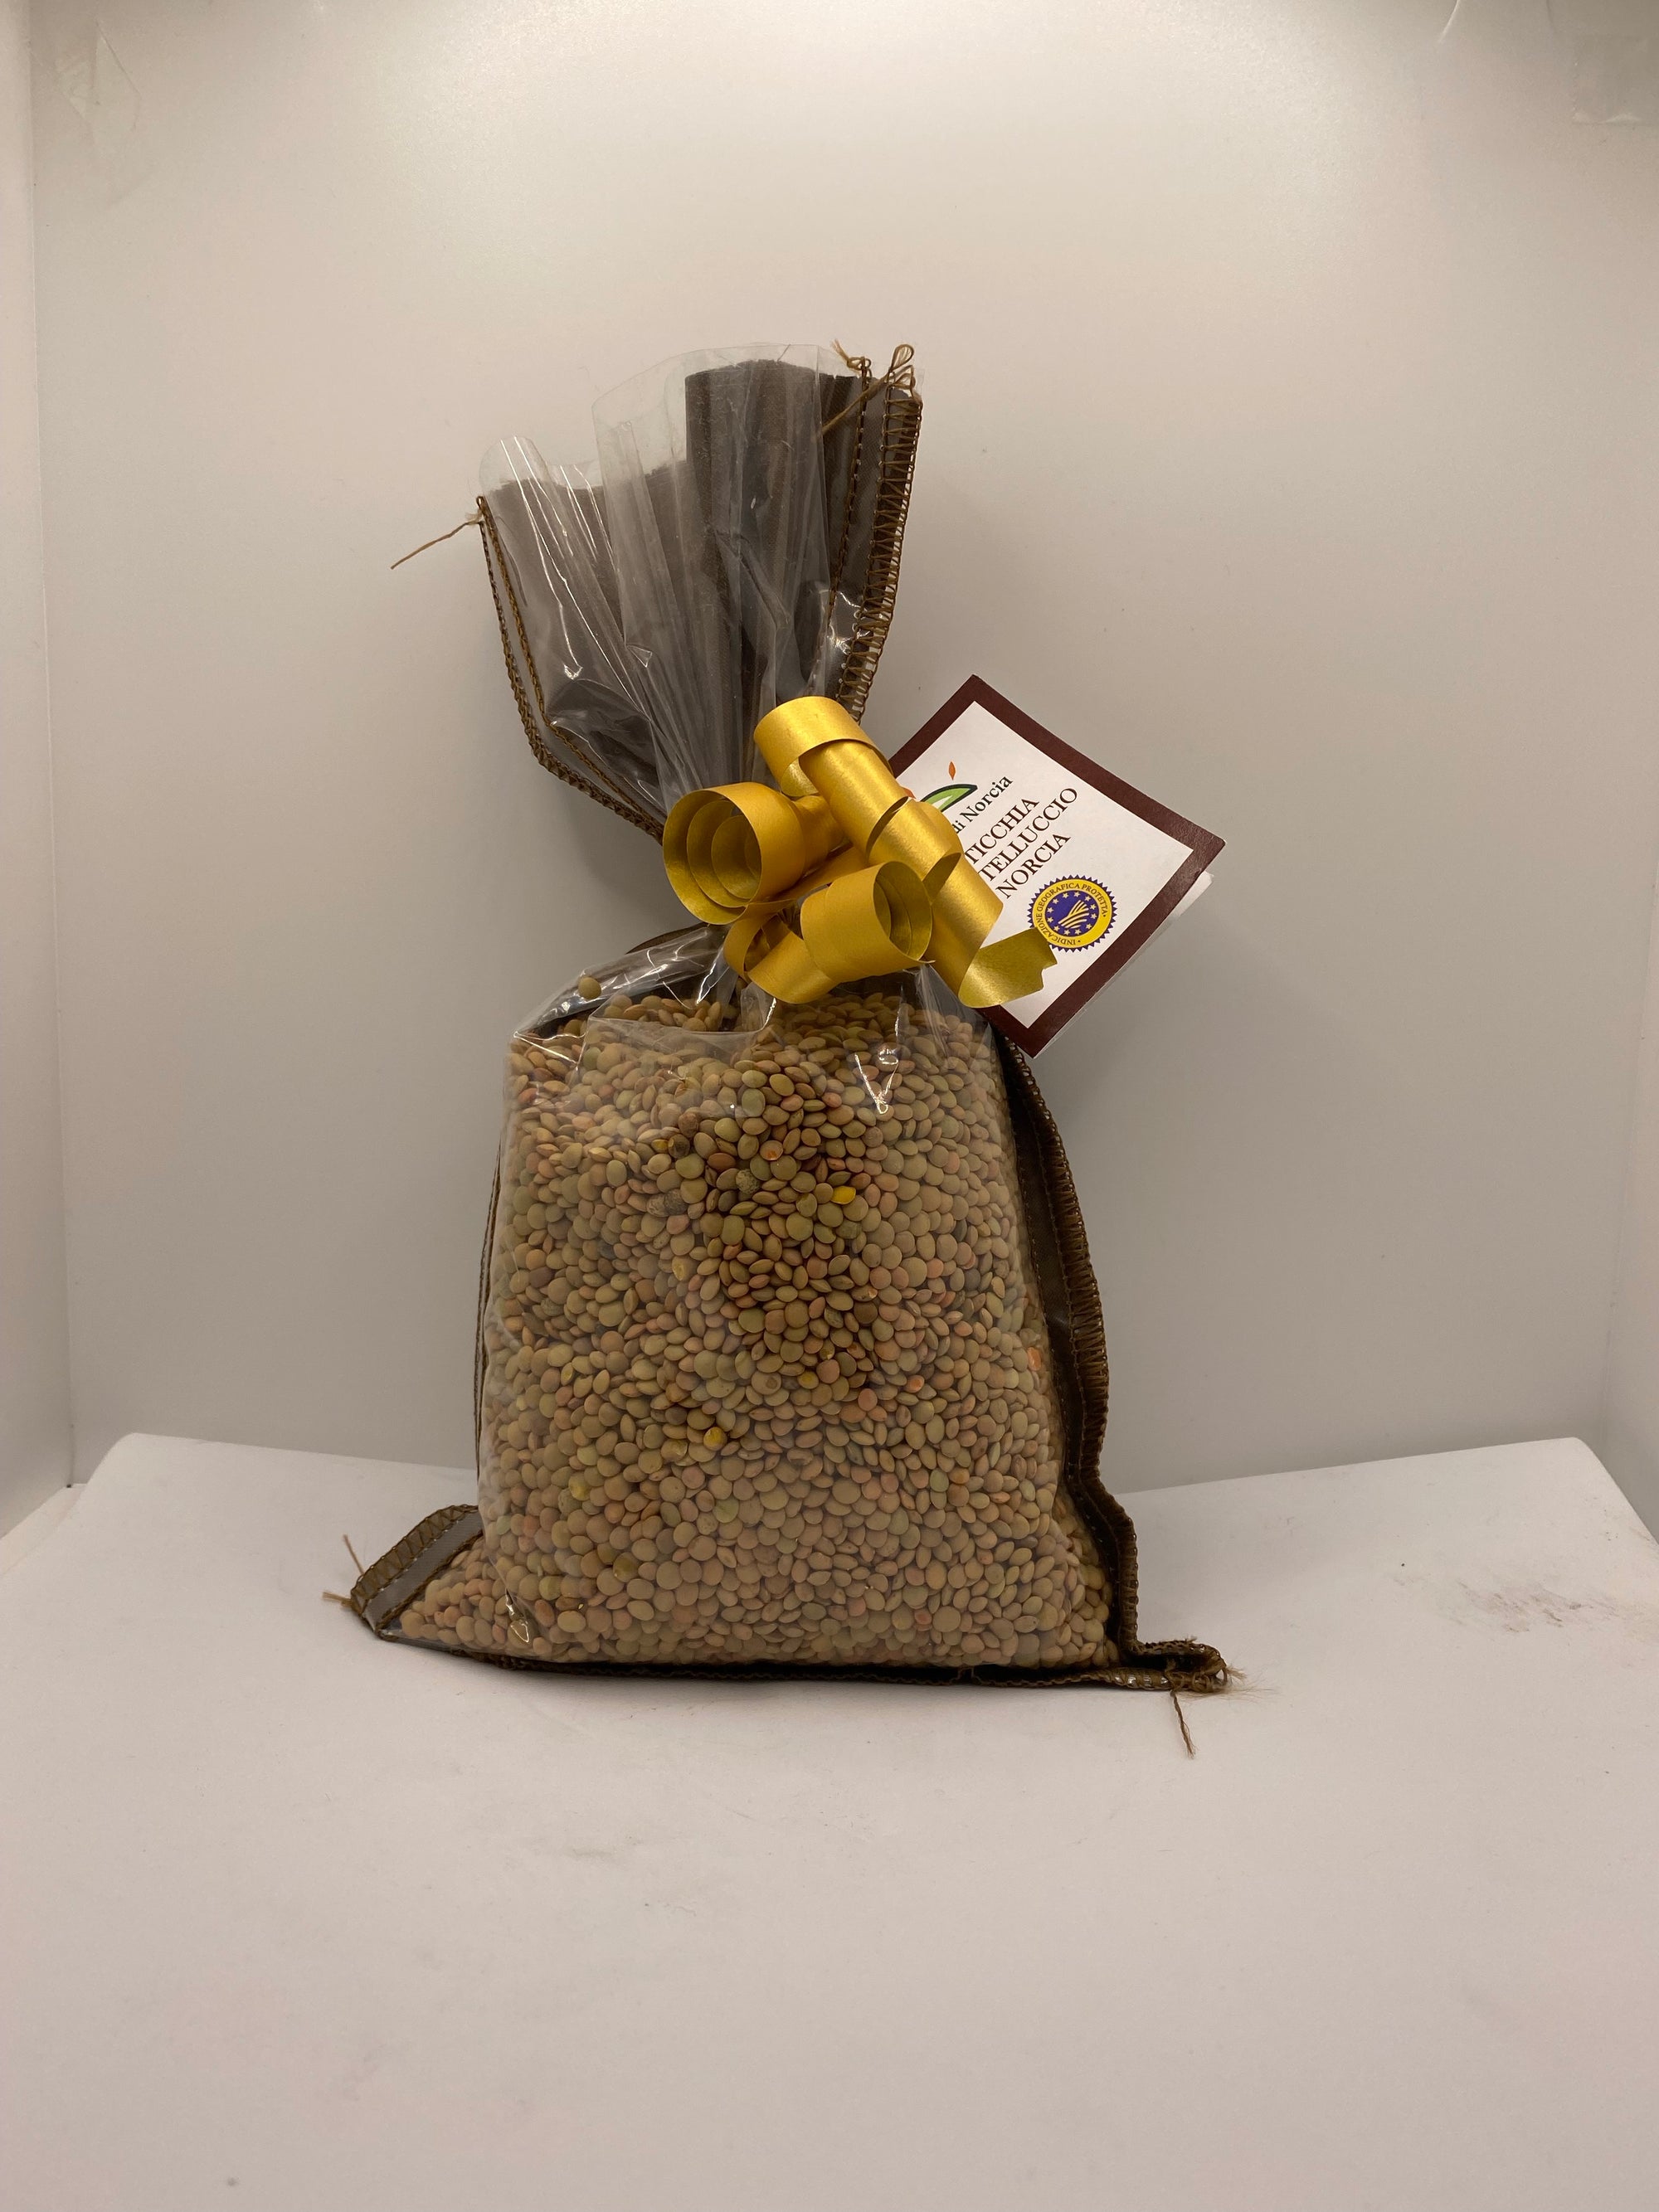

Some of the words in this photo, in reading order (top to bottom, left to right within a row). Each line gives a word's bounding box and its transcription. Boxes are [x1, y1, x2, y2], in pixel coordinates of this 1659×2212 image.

[966, 775, 1013, 823] Norcia
[965, 799, 1039, 865] TICCHIA
[978, 787, 1078, 882] TELLUCCIO
[995, 833, 1071, 900] NORCIA
[1037, 882, 1080, 911] GEOGRAFICA
[1082, 883, 1109, 915] PROTETTA
[1036, 916, 1076, 946] INDICAZIONE
